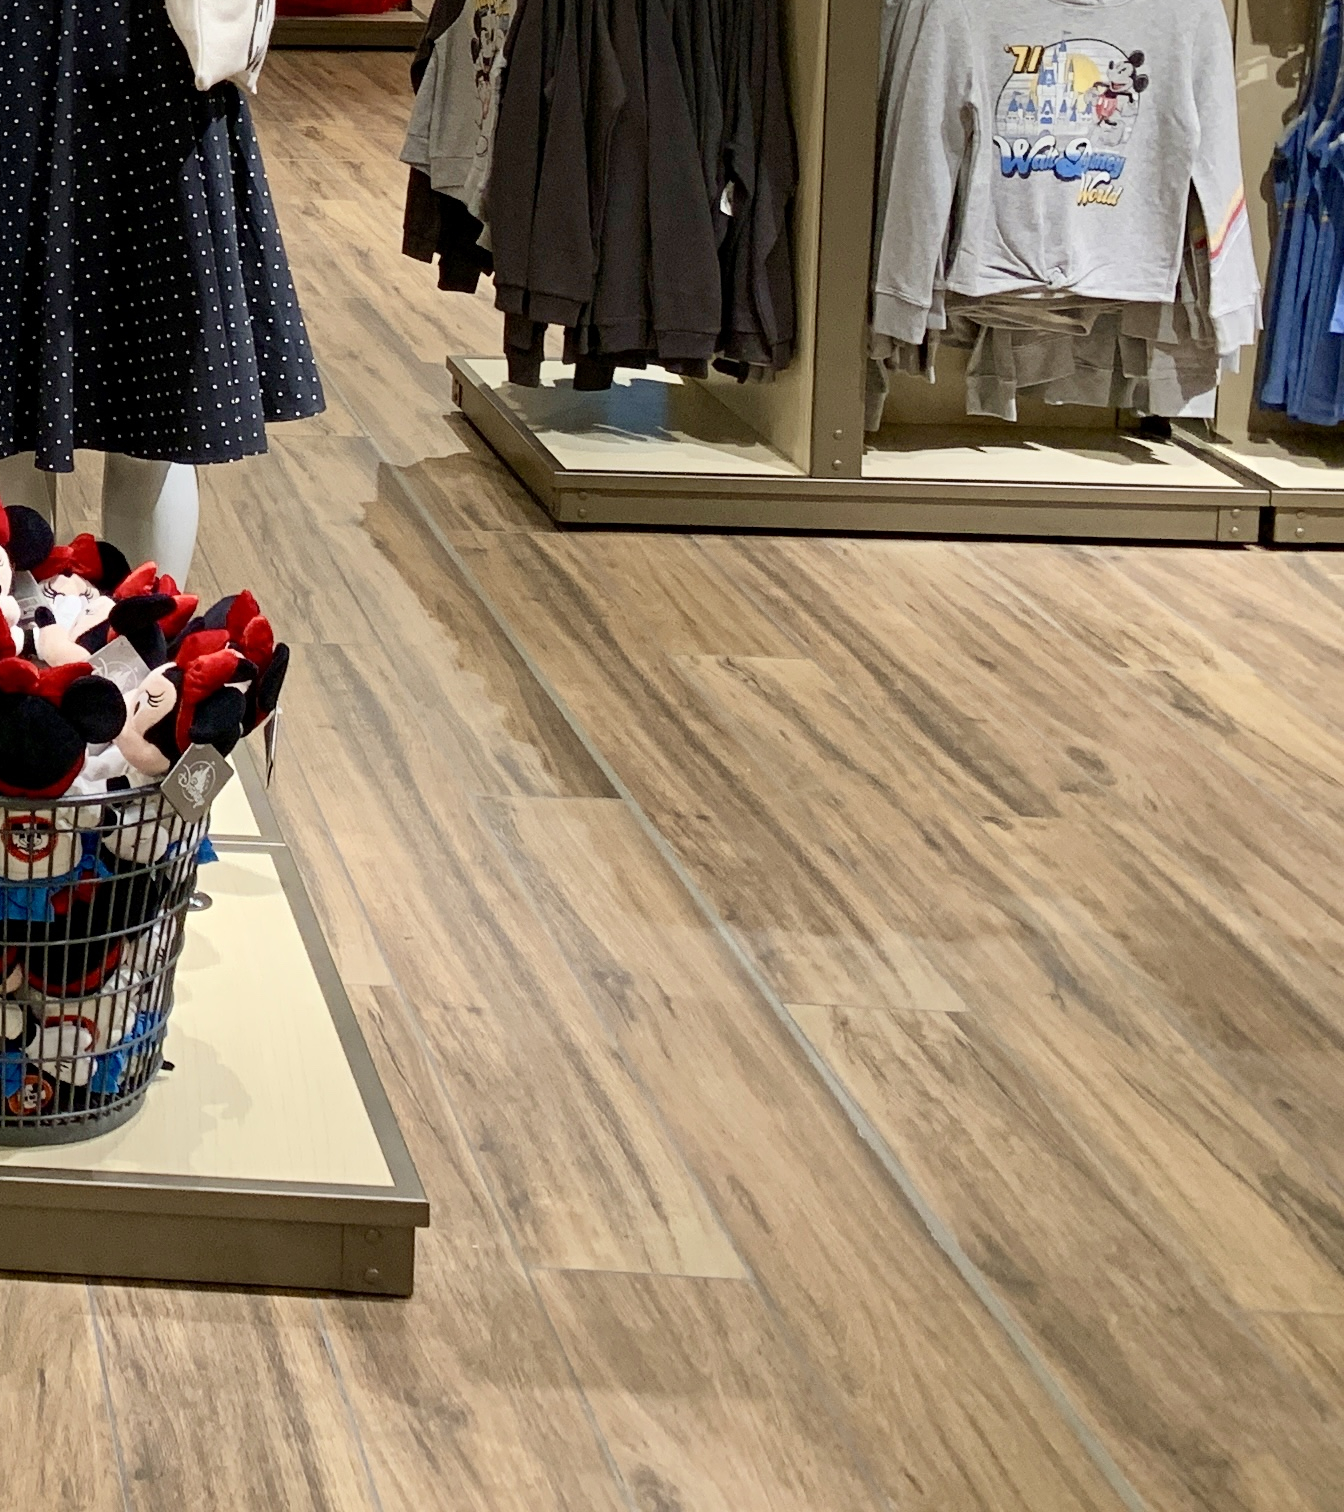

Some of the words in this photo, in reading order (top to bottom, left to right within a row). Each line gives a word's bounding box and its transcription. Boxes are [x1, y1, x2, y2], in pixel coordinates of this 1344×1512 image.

[991, 135, 1061, 180] Walt
[1054, 137, 1127, 183] Disney
[1076, 171, 1125, 208] World
